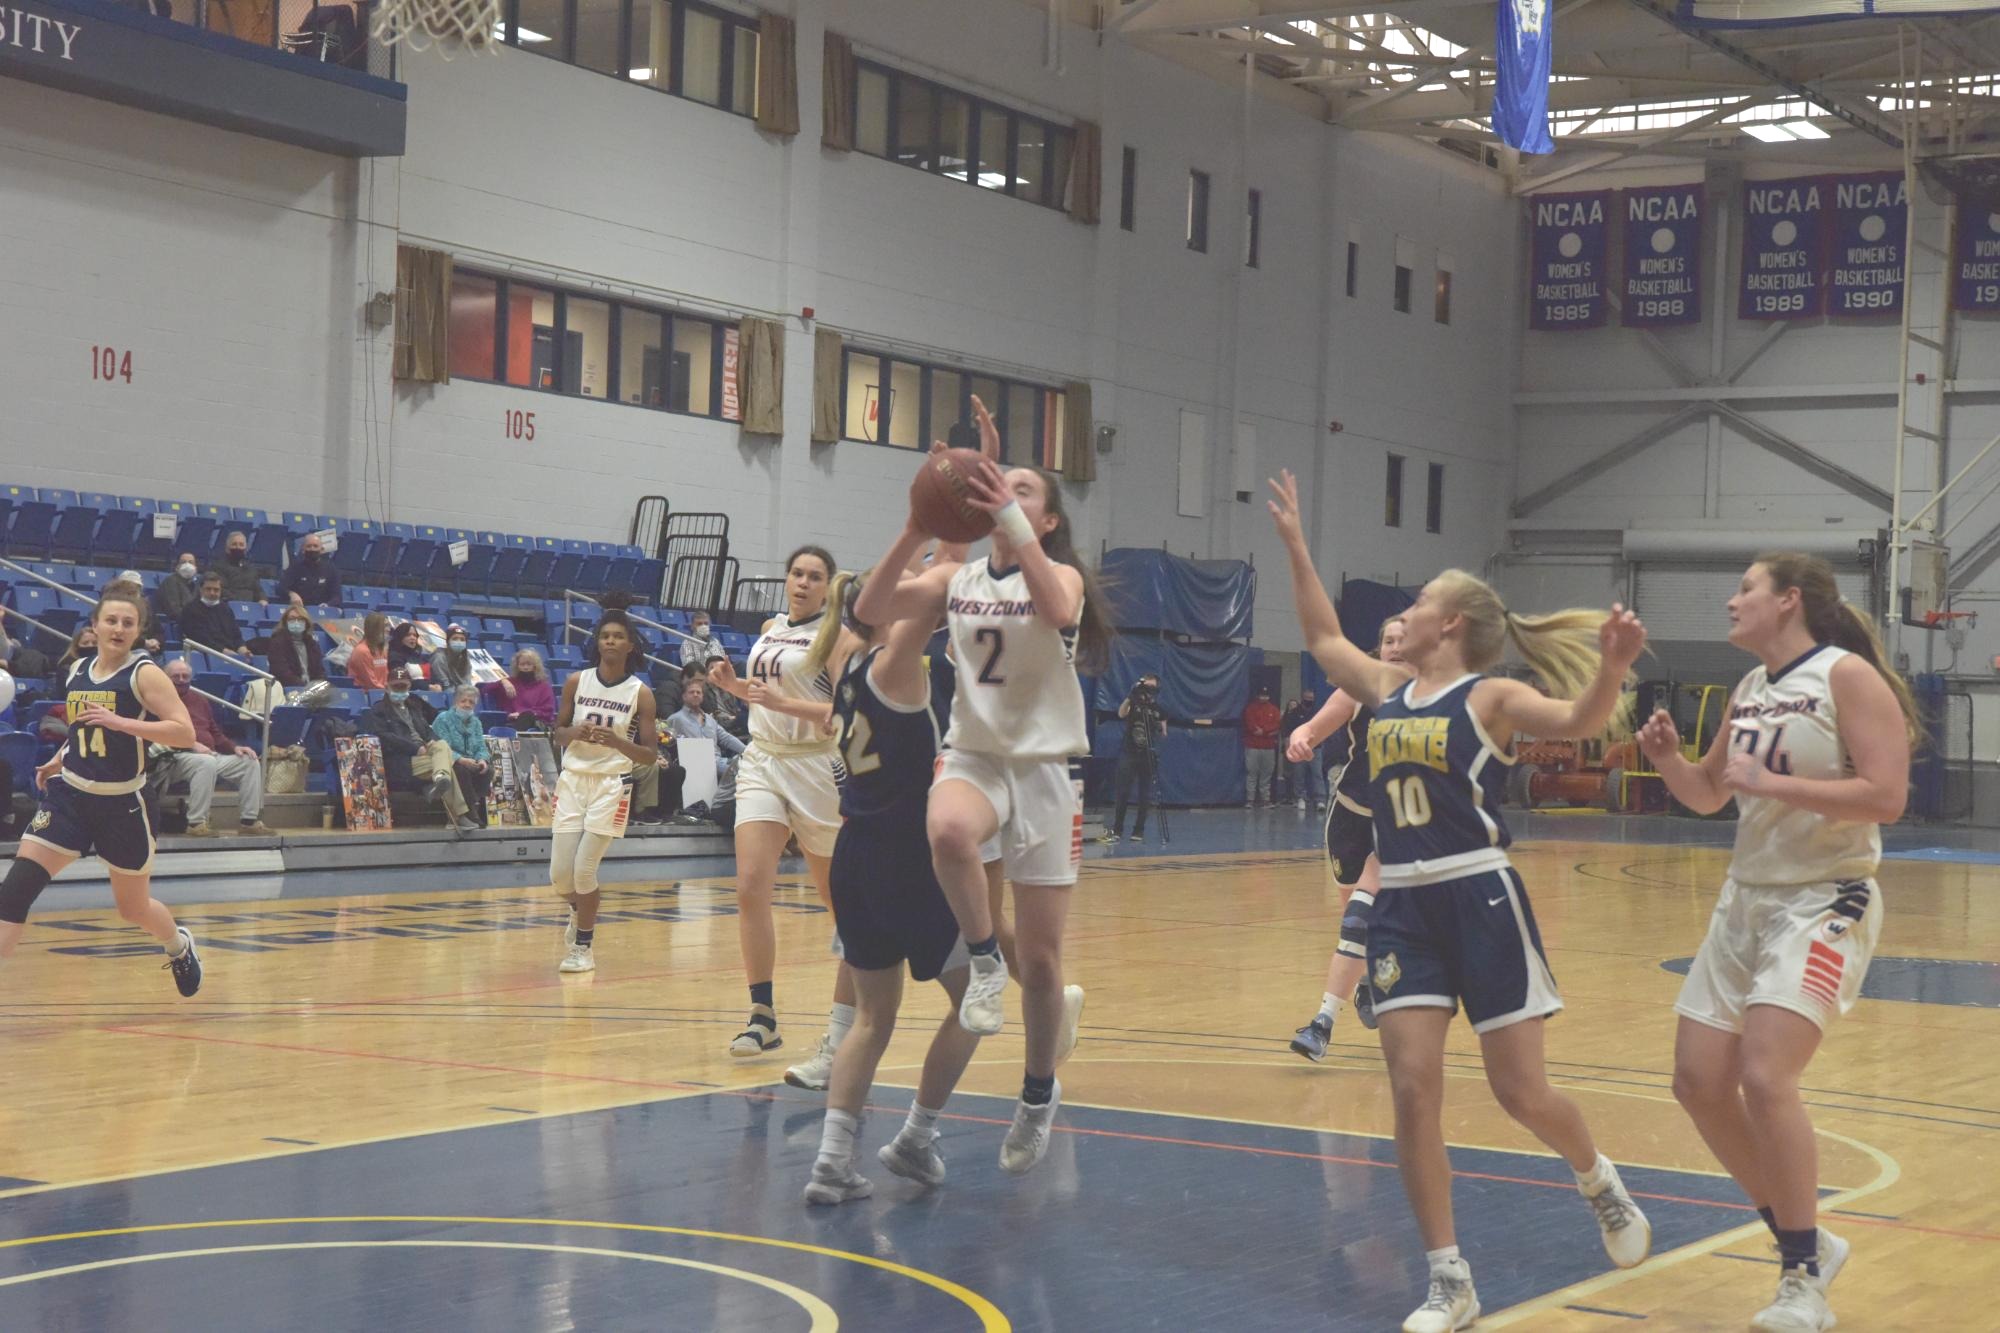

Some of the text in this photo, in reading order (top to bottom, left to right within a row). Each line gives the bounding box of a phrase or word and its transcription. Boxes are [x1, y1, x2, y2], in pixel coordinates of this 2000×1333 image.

[0, 6, 81, 60] ITY
[1749, 186, 1822, 214] NCAA
[1836, 180, 1911, 209] NCAA
[1537, 200, 1603, 226] NCAA
[1629, 194, 1697, 222] NCAA
[1759, 250, 1807, 269] WOMEN'S
[1847, 245, 1897, 265] WOMEN'S
[1547, 261, 1592, 279] WOMEN'S
[1639, 256, 1685, 275] WOMEN'S
[1628, 277, 1693, 296] BASKETBALL
[1747, 271, 1815, 291] BASKETBALL
[1834, 266, 1905, 287] BASKETBALL
[1536, 281, 1600, 300] BASKETBALL
[1844, 290, 1894, 308] 1990
[1975, 285, 1999, 303] 19
[1545, 303, 1591, 321] 1985
[1637, 299, 1685, 317] 1988
[1755, 294, 1805, 312] 1989
[92, 345, 132, 385] 104
[505, 409, 536, 441] 105
[975, 627, 1005, 684] 2
[752, 648, 784, 686] 44
[577, 695, 632, 715] WESTCONN
[77, 727, 107, 758] 14
[1386, 775, 1432, 828] 10
